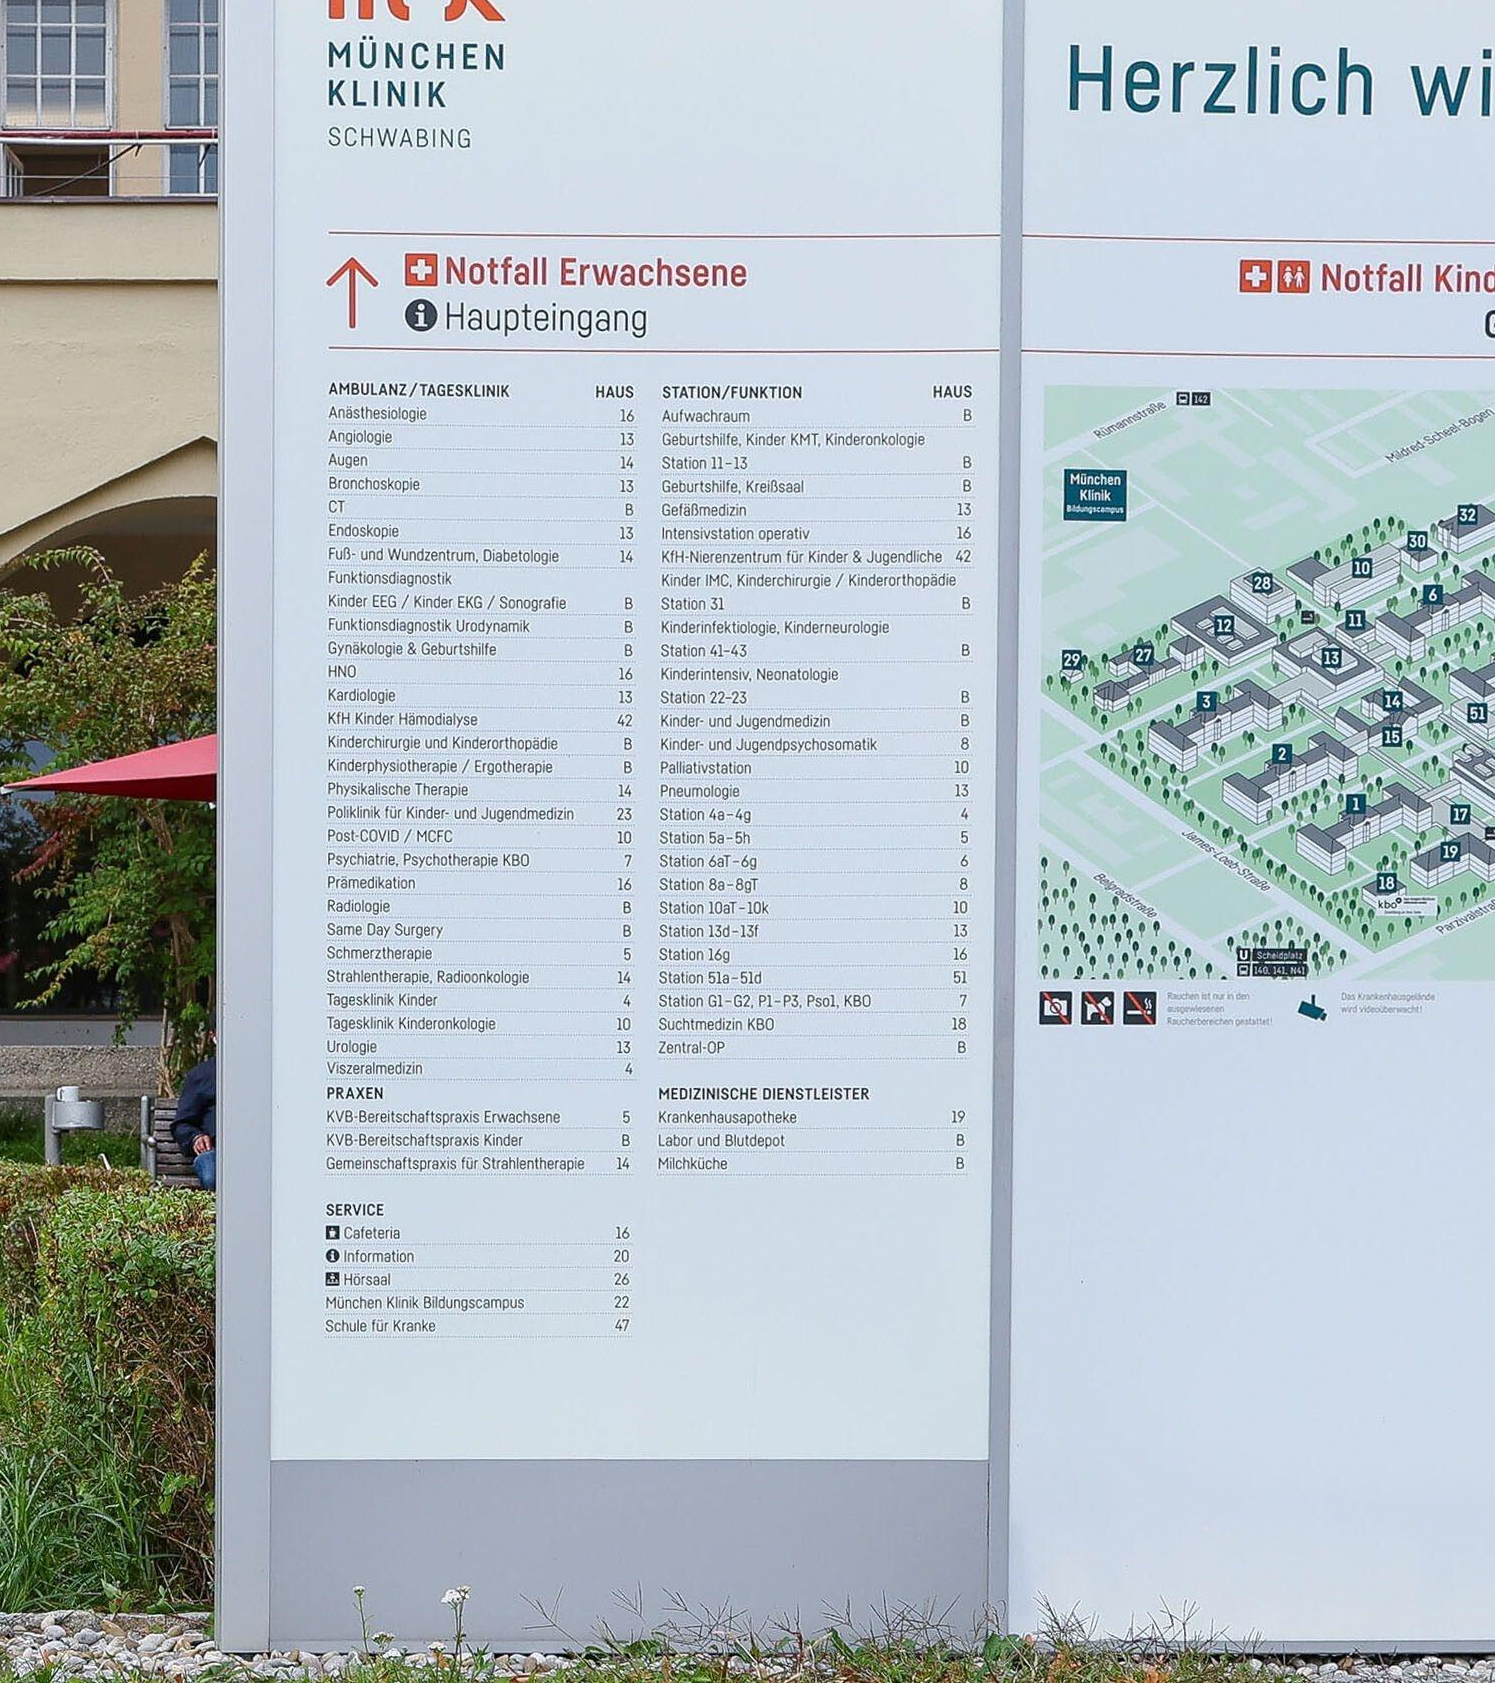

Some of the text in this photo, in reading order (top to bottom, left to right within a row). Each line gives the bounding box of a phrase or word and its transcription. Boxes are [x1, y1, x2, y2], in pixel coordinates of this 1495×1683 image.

[328, 36, 505, 70] MÜNCHEN
[1069, 46, 1374, 115] Herzlich
[328, 80, 447, 107] KLINIK
[328, 126, 471, 148] SCHWABING
[446, 257, 747, 288] Notfall Erwachsene
[1321, 263, 1423, 294] Notfall
[446, 302, 647, 339] Haupteingang
[596, 385, 634, 398] HAUS
[933, 385, 973, 398] HAUS
[328, 406, 635, 422] Anästhesiologie 16
[662, 409, 972, 423] Aufwachraum B
[328, 429, 634, 446] Angiologie 13
[1386, 407, 1495, 463] Mildred-Scheel-Bogen
[328, 453, 634, 470] Augen 14
[328, 477, 634, 493] Bronchoskopie 13
[1070, 473, 1121, 486] München
[1079, 489, 1111, 501] Klinik
[662, 503, 972, 517] Gefäßmedizin 13
[1066, 504, 1124, 515] Bildungscampus
[328, 524, 634, 540] Endoskopie 13
[661, 527, 972, 543] Intensivstation operativ 16
[1409, 534, 1426, 548] 30
[1254, 576, 1271, 590] 28
[1215, 619, 1232, 633] 12
[1063, 653, 1080, 667] 29
[328, 665, 633, 680] HNO 16
[328, 688, 633, 704] Kardiologie 13
[661, 761, 969, 775] Palliativstation 10
[660, 784, 969, 801] Pneumologie 13
[1181, 830, 1271, 892] James-Loeb-Straße
[327, 876, 632, 890] Prämedikation 16
[1093, 873, 1158, 919] Belgradstraße
[327, 899, 631, 915] Radiologie B
[327, 947, 631, 962] Schmerztherapie 5
[659, 1018, 966, 1031] Suchtmedizin KBO 18
[327, 1040, 631, 1056] Urologie 13
[659, 1041, 966, 1054] Zentral-OP B
[327, 1087, 384, 1100] PRAXEN
[659, 1088, 870, 1100] MEDIZINISCHE DIENSTLEISTER
[658, 1110, 966, 1126] Krankenhausapotheke 19
[658, 1157, 965, 1170] Milchküche B
[326, 1204, 384, 1217] SERVICE
[344, 1226, 630, 1240] Cafeteria 16
[344, 1250, 630, 1264] Information 20
[344, 1273, 630, 1287] Hörsaal 26
[325, 1319, 630, 1333] Schule für Kranke 47
